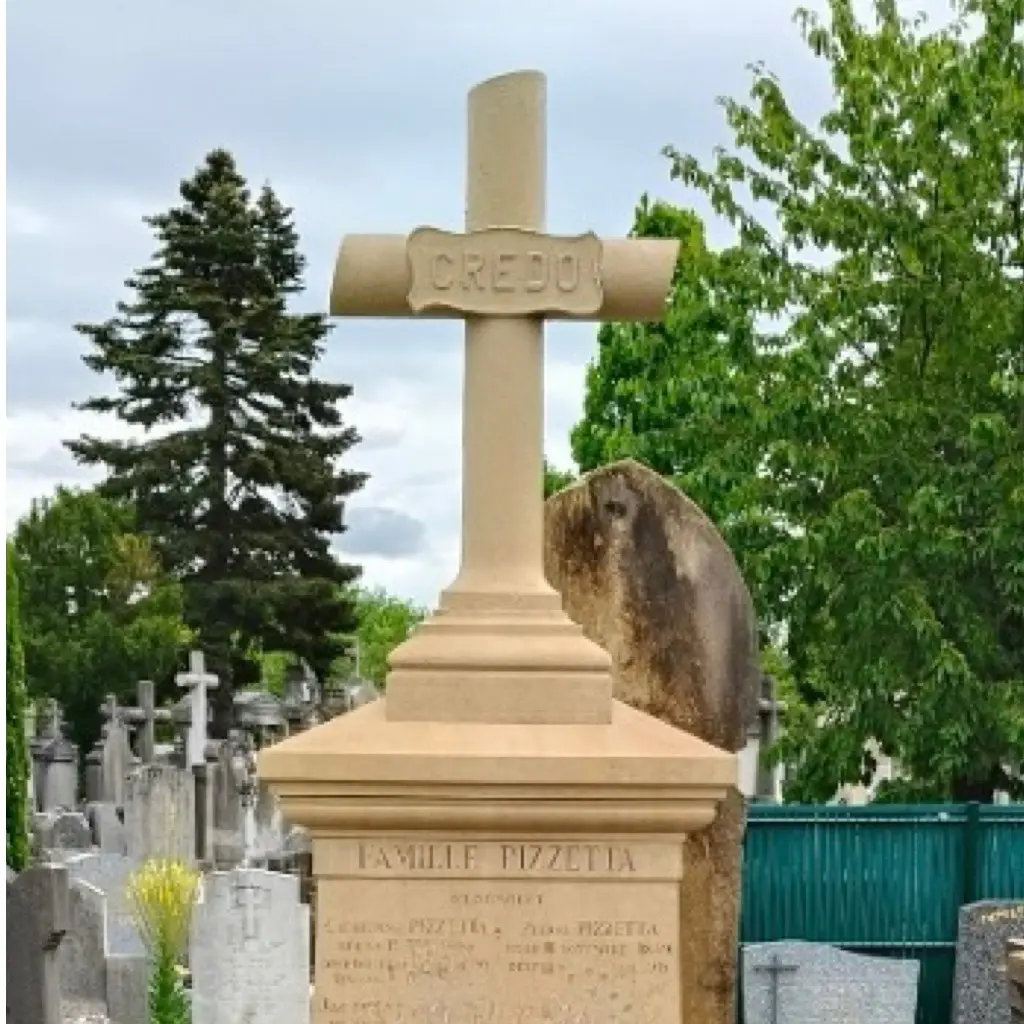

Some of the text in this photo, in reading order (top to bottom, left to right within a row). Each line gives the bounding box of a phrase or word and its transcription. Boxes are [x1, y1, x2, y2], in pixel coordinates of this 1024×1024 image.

[431, 252, 580, 293] CREDO
[357, 844, 637, 872] FAMILLE PIZZETTA
